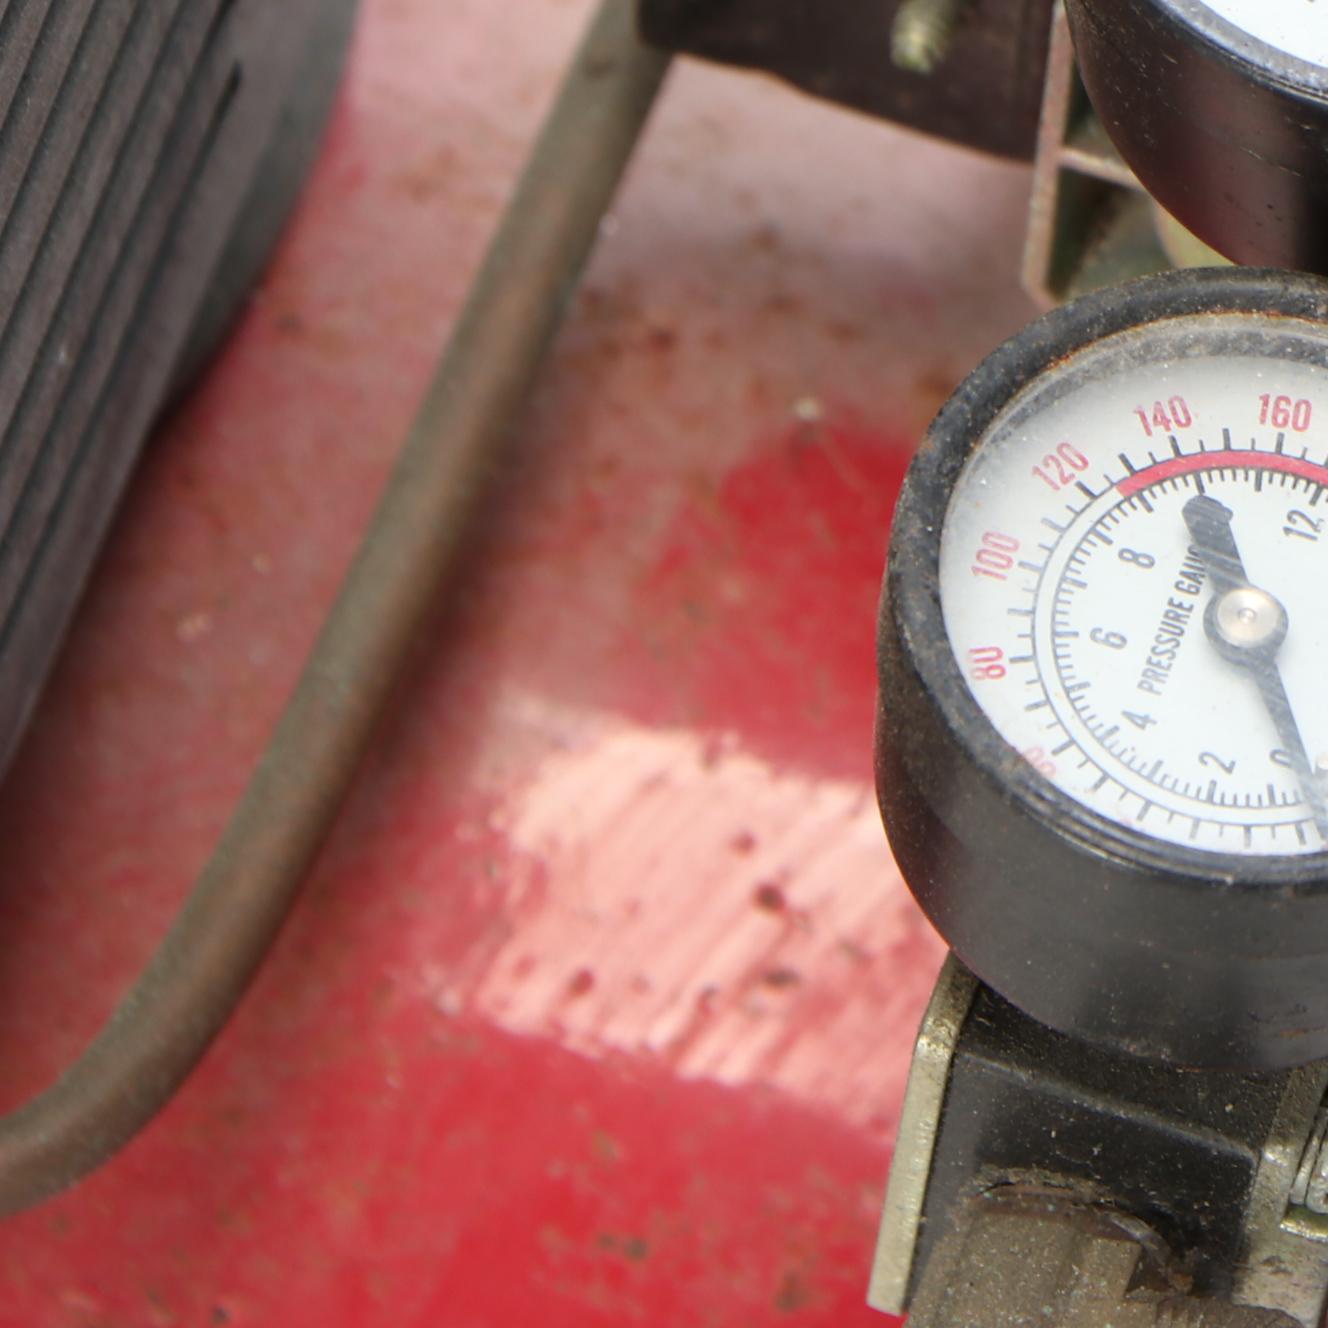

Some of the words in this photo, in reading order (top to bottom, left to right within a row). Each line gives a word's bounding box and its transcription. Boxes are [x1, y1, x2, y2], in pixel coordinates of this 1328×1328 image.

[1132, 396, 1193, 437] 140
[1258, 392, 1312, 432] 160
[1031, 442, 1089, 491] 120
[1282, 509, 1325, 541] 12
[971, 531, 1020, 581] 100
[1117, 547, 1156, 570] 8
[1089, 627, 1128, 650] 6
[1137, 597, 1194, 696] PRESSURE
[969, 646, 1006, 681] 80
[1121, 709, 1158, 731] 4
[1198, 751, 1236, 775] 2
